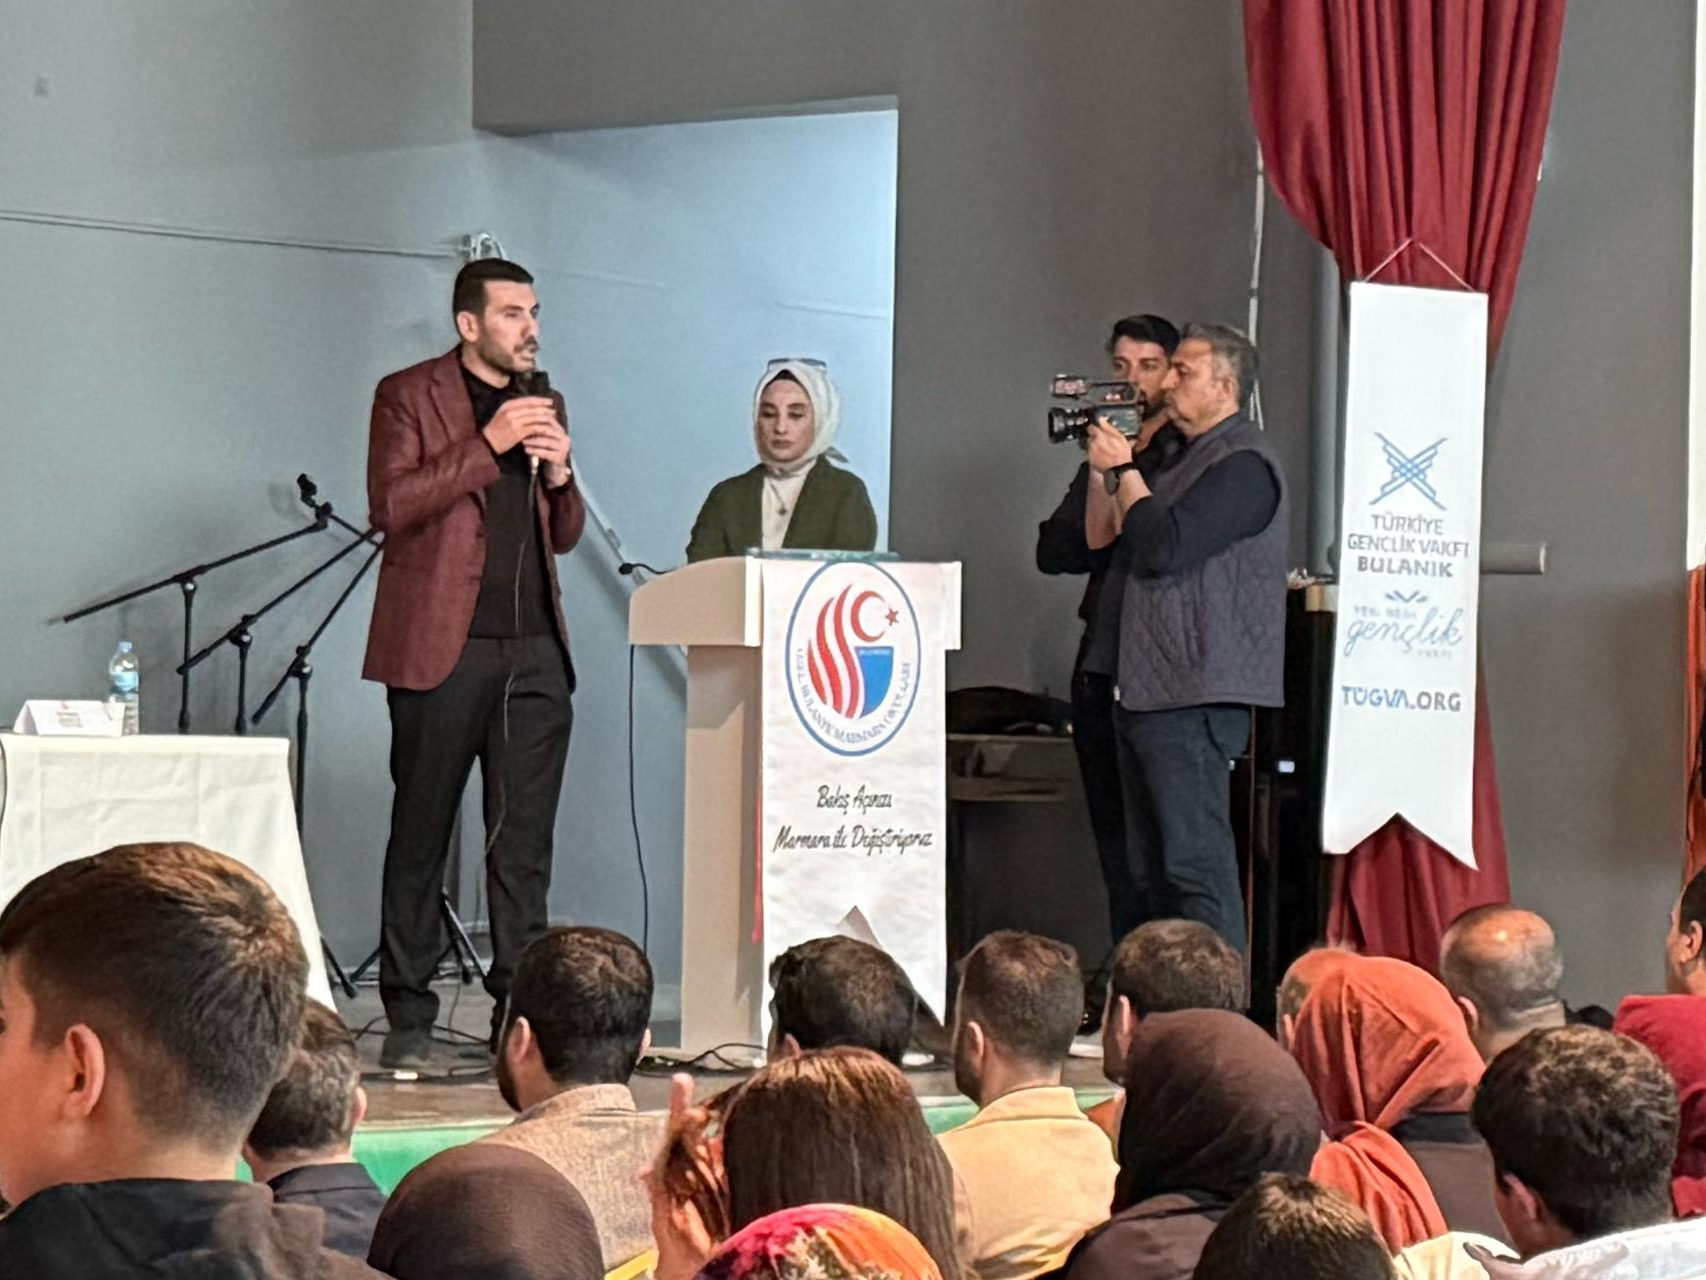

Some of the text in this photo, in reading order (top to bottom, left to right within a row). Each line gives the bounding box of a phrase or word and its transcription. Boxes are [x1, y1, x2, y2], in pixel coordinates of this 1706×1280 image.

[1371, 511, 1444, 535] TÜRKİYE
[1419, 539, 1469, 558] VAKFI
[1357, 556, 1453, 578] BULANIK
[1343, 606, 1464, 657] gençlik
[772, 825, 832, 853] Marmara
